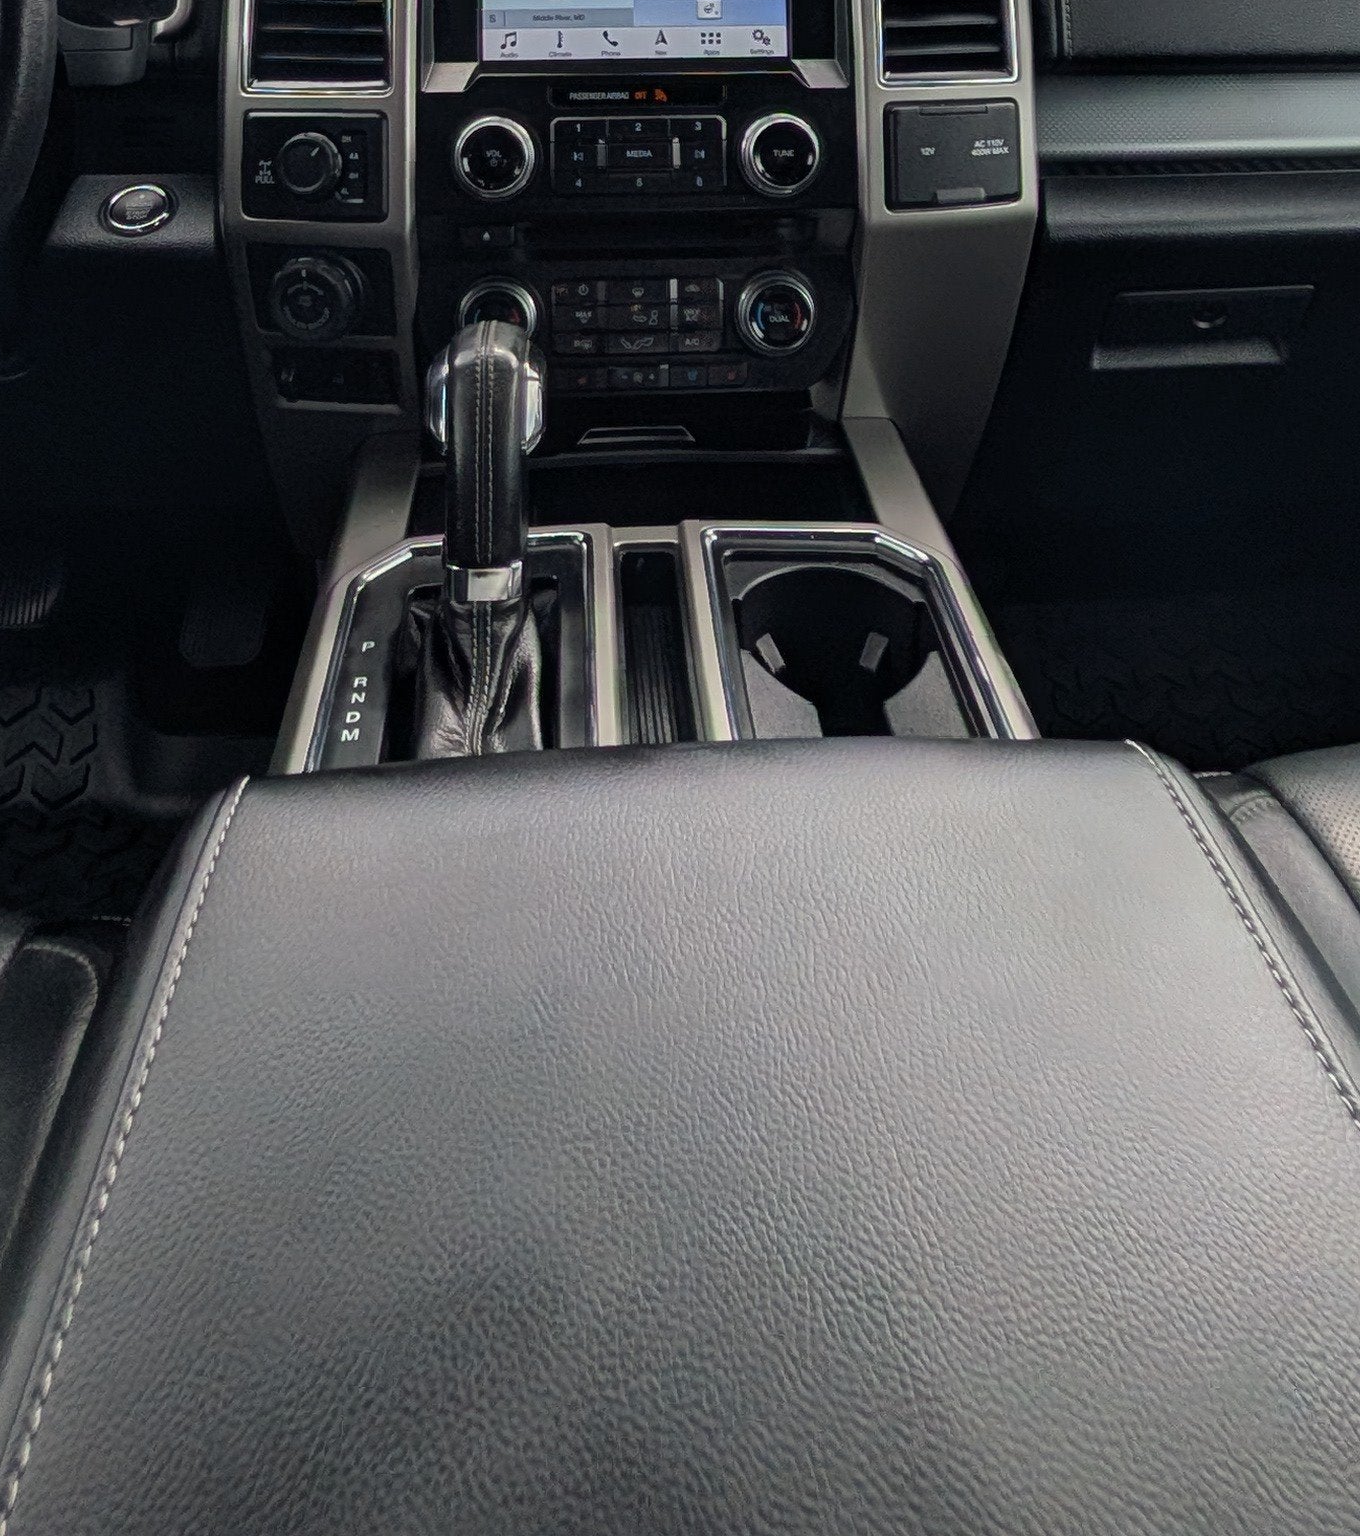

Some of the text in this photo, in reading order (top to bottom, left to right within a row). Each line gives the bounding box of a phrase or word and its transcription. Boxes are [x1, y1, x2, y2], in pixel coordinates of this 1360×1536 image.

[626, 150, 653, 158] MEDIA
[576, 178, 583, 188] 4
[361, 641, 375, 652] P
[354, 677, 367, 688] R
[351, 692, 366, 704] N
[346, 711, 360, 723] D
[341, 728, 360, 742] M
